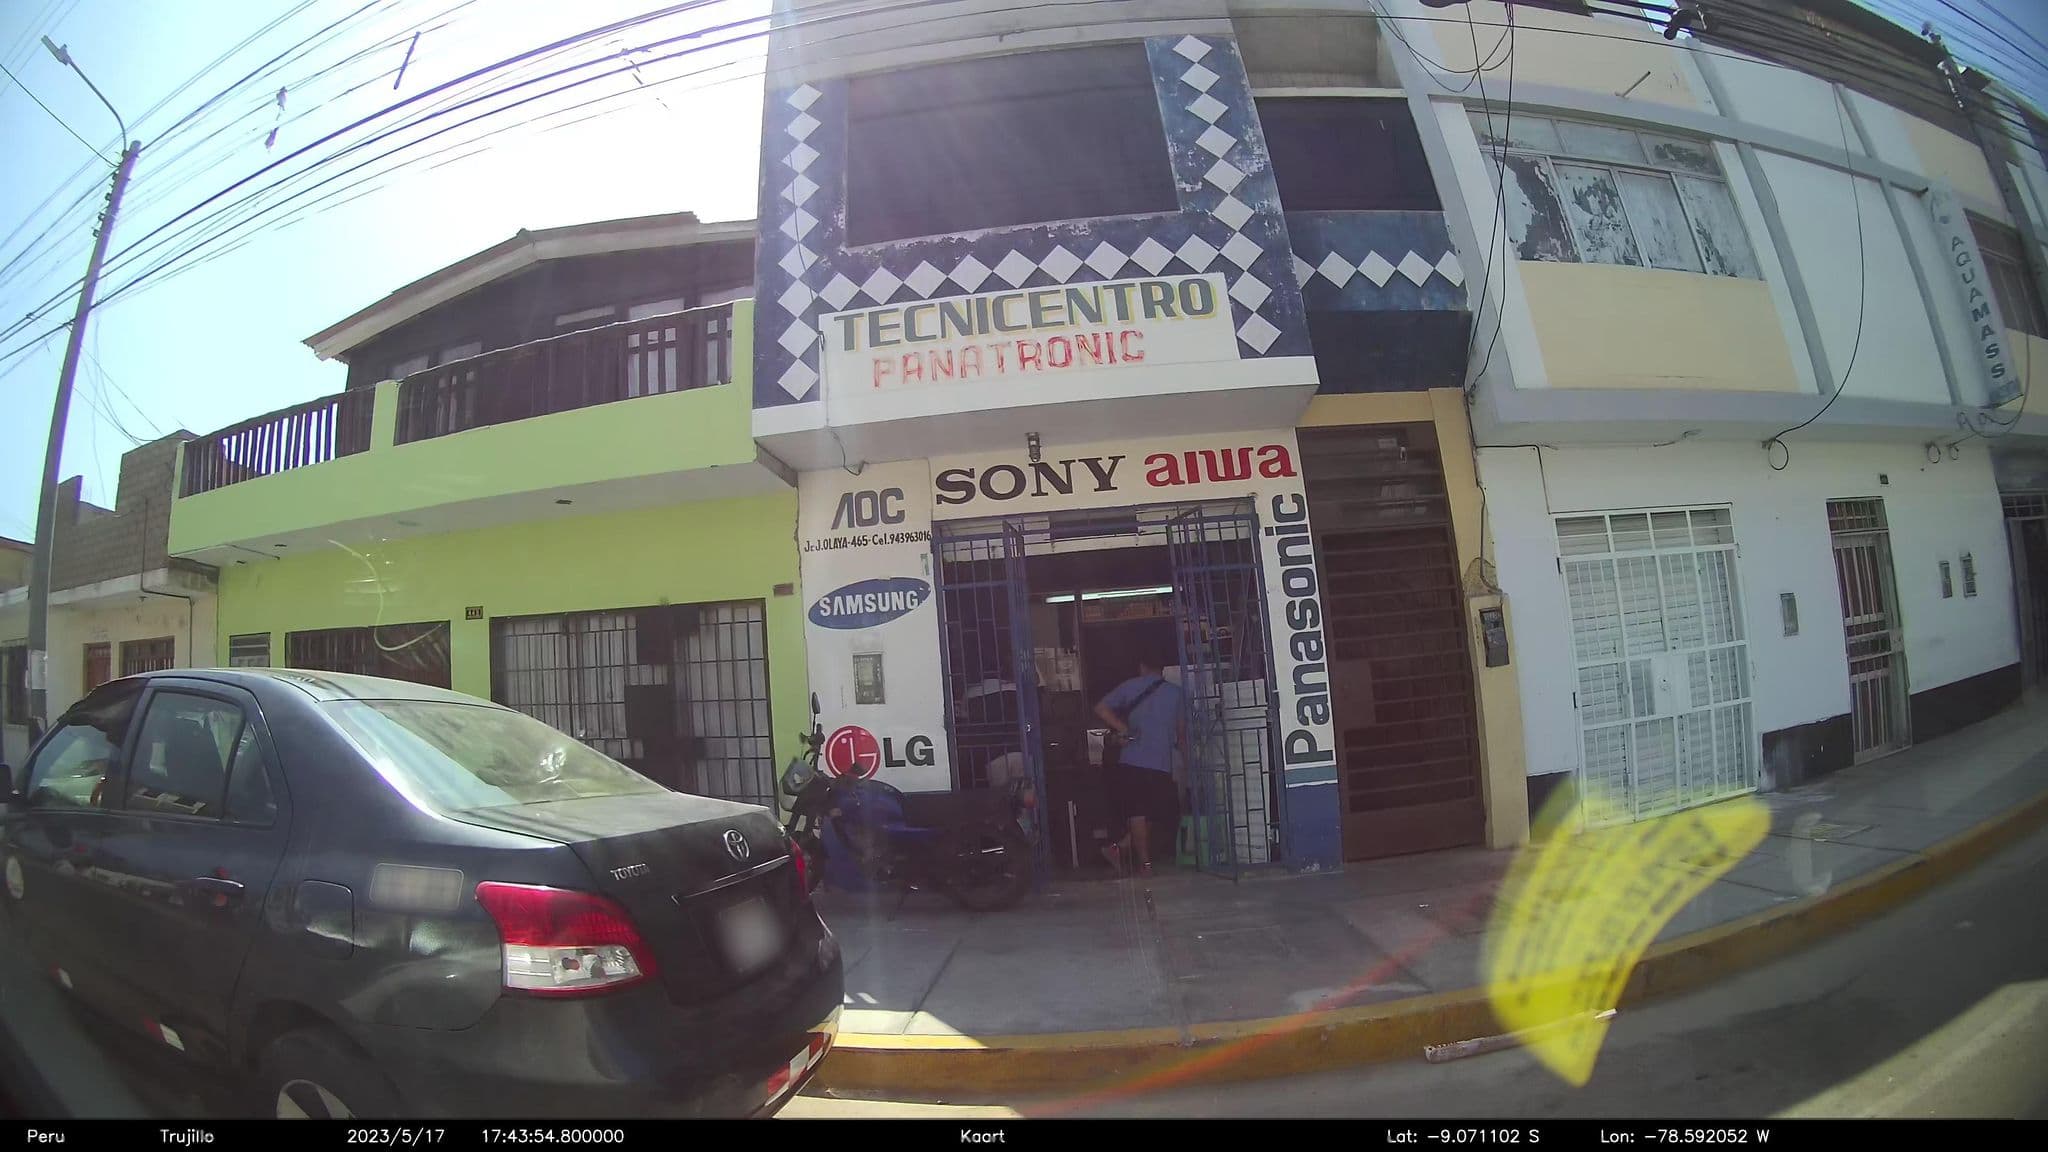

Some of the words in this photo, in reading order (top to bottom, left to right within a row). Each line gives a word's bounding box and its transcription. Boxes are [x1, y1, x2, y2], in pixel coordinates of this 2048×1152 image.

[833, 277, 1217, 351] TECNICENTRO
[1951, 235, 2006, 379] AGUAMASS
[872, 330, 1145, 389] PANATRONIC
[935, 455, 1127, 505] SONY
[1144, 444, 1298, 488] aiwa
[831, 487, 906, 531] AOC
[818, 590, 920, 617] SAMSUNG
[1265, 493, 1334, 766] Panasonic
[883, 733, 936, 768] LG
[610, 862, 650, 881] TOYOTA
